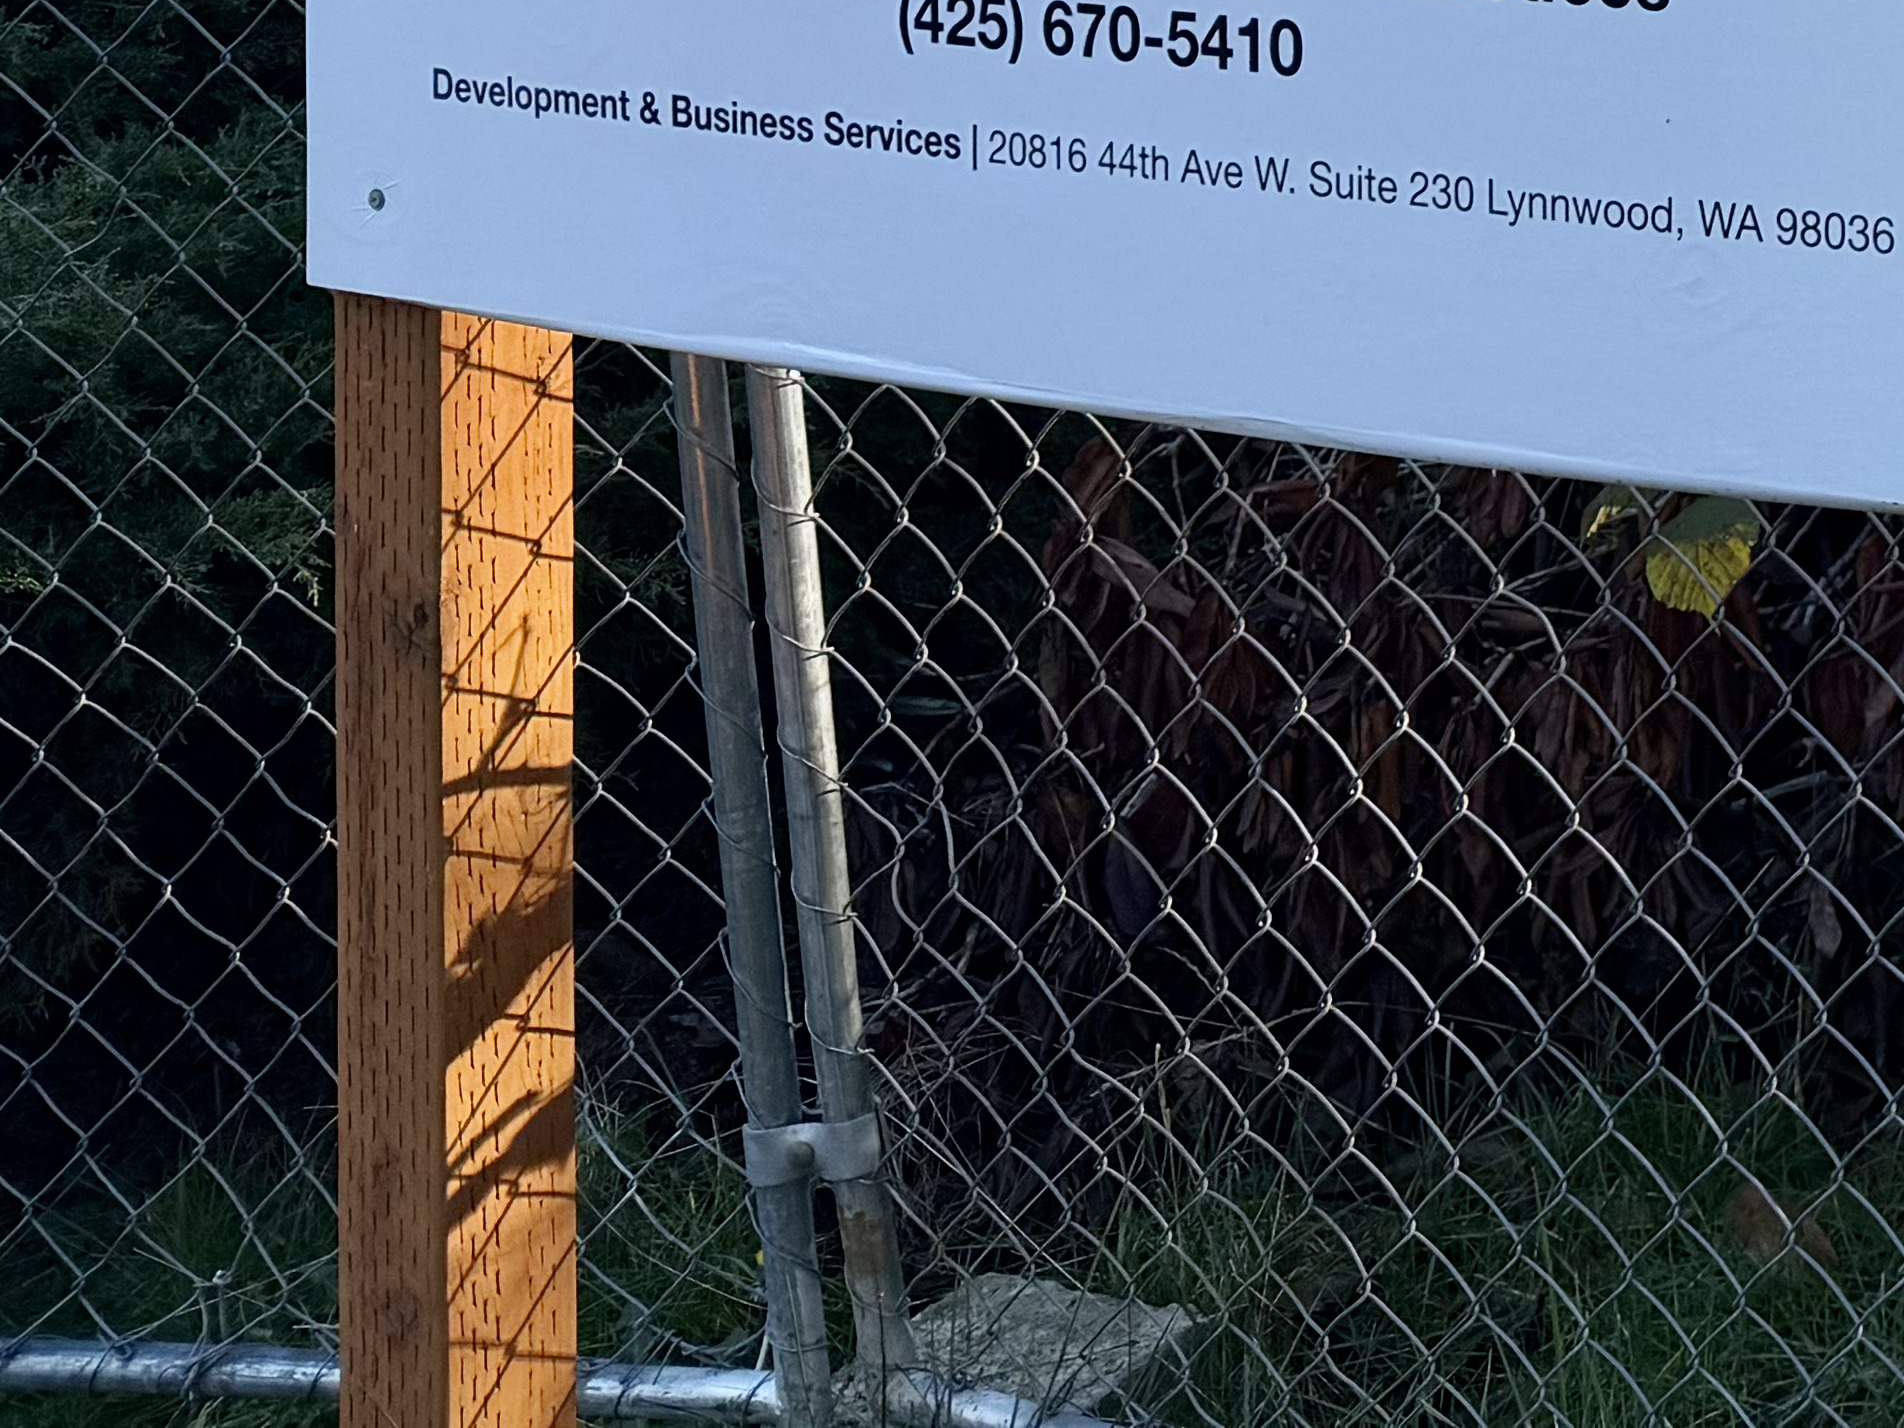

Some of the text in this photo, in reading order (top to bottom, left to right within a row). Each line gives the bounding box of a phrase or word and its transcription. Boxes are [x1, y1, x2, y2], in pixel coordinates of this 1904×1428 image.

[1042, 0, 1304, 77] 670-5410
[432, 67, 1895, 255] Development & Business Services 20816 44th Ave W. Suite 230 Lynnwood, WA 98036
